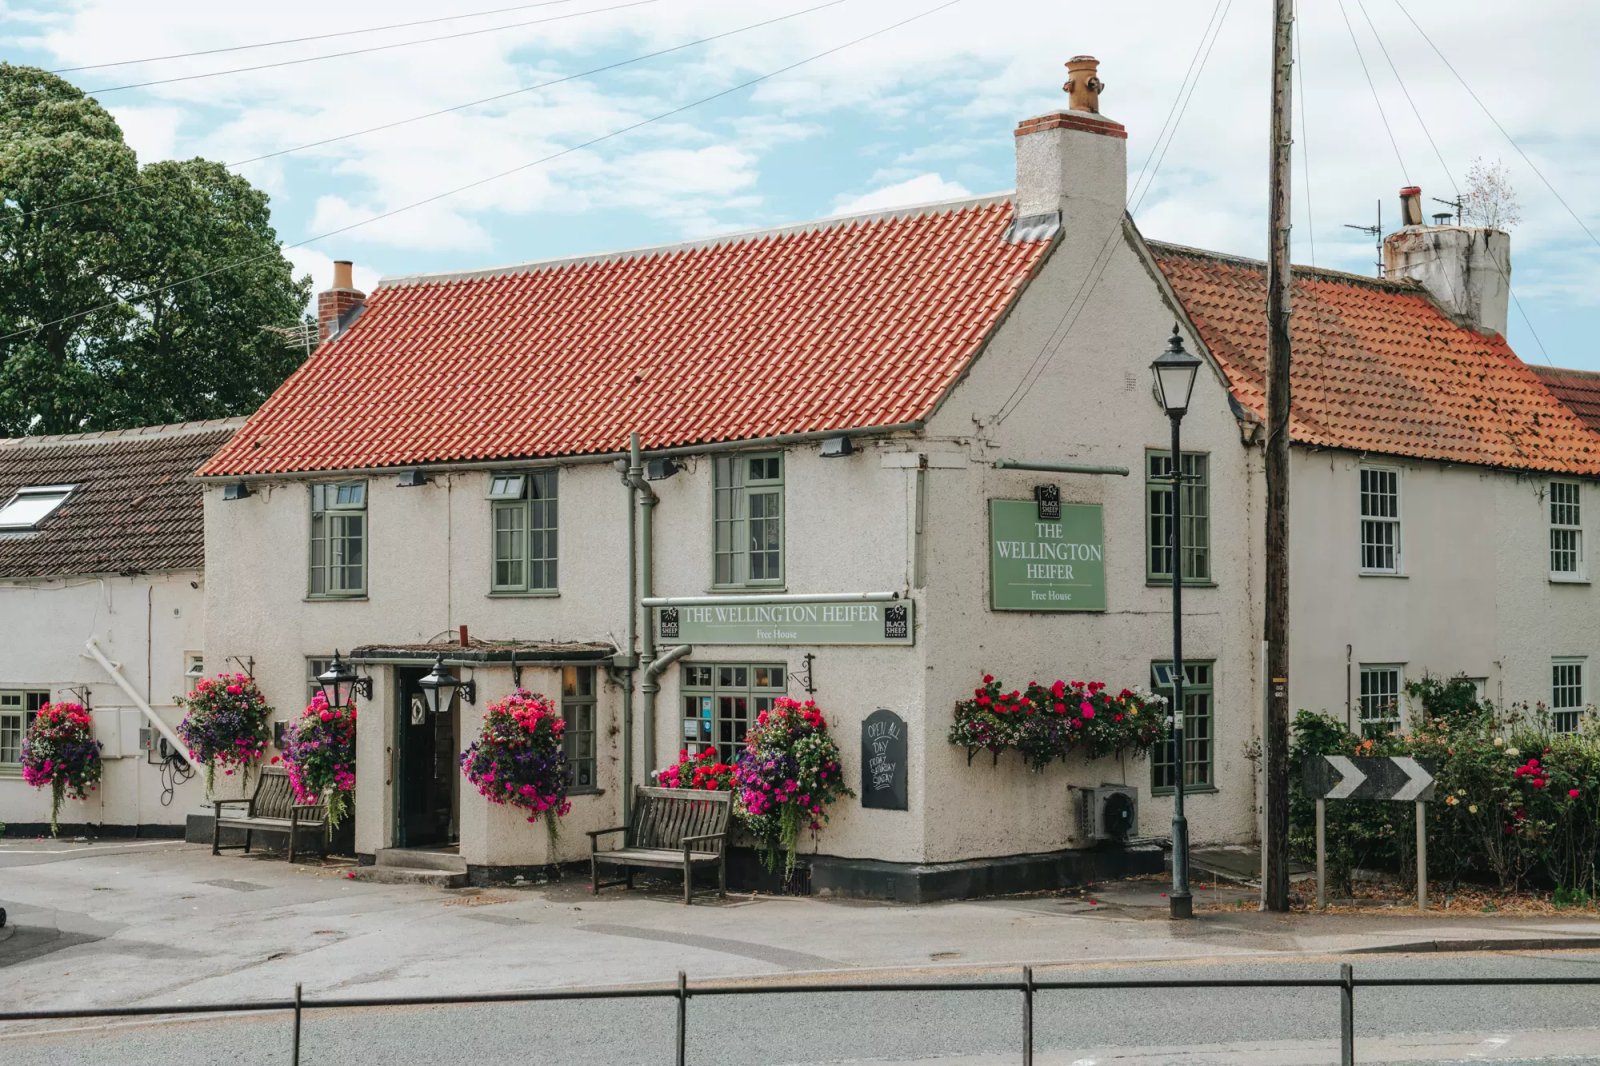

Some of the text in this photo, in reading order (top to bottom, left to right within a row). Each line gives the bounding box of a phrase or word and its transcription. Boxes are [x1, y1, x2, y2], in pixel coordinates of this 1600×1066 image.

[1035, 523, 1063, 538] THE
[996, 540, 1102, 561] WELLINGTON
[1027, 563, 1074, 579] HEIFER
[1031, 590, 1072, 601] Free House
[684, 605, 879, 623] THE WELLINGTON HEIFER
[756, 629, 797, 639] Free House
[868, 721, 901, 740] OPEN ALL
[872, 740, 888, 753] DAY
